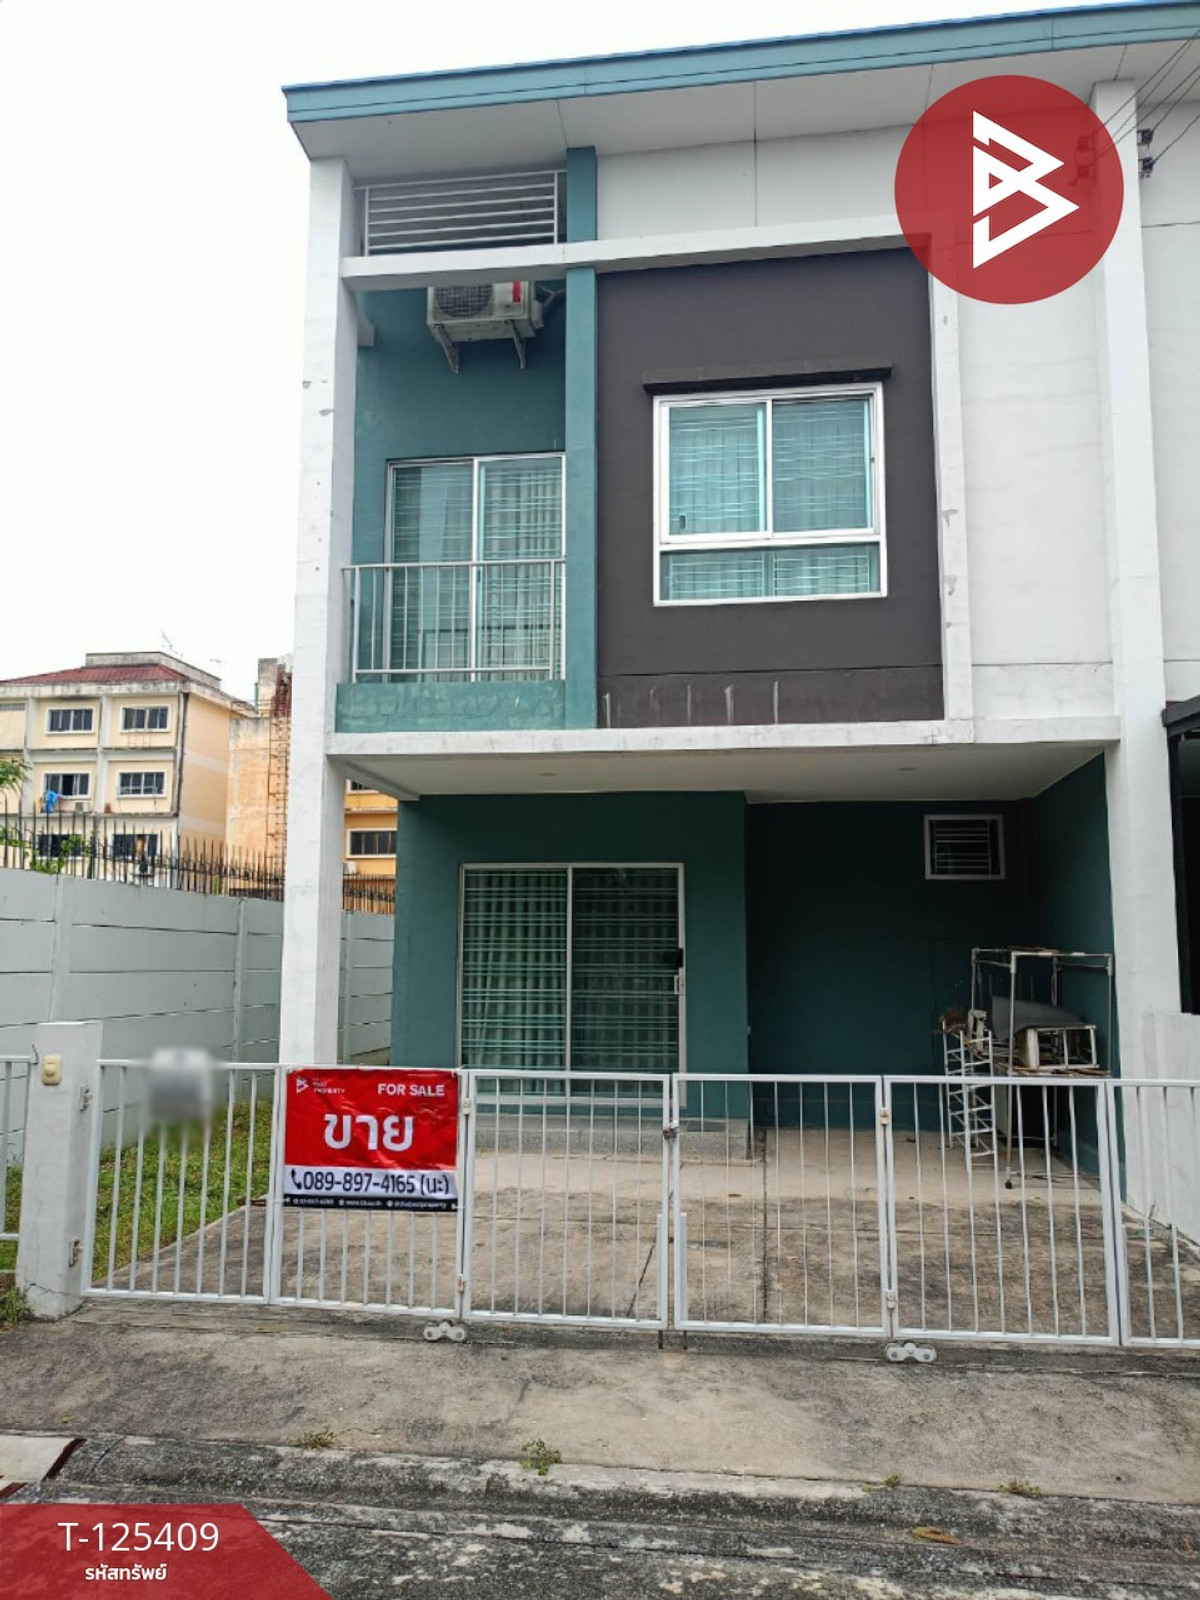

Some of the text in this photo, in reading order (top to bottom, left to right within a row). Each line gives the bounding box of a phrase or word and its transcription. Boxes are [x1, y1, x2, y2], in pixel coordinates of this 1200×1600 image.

[378, 1083, 446, 1097] FOR SALE
[323, 1113, 414, 1152] ขาย
[303, 1171, 416, 1193] 089-897-4165
